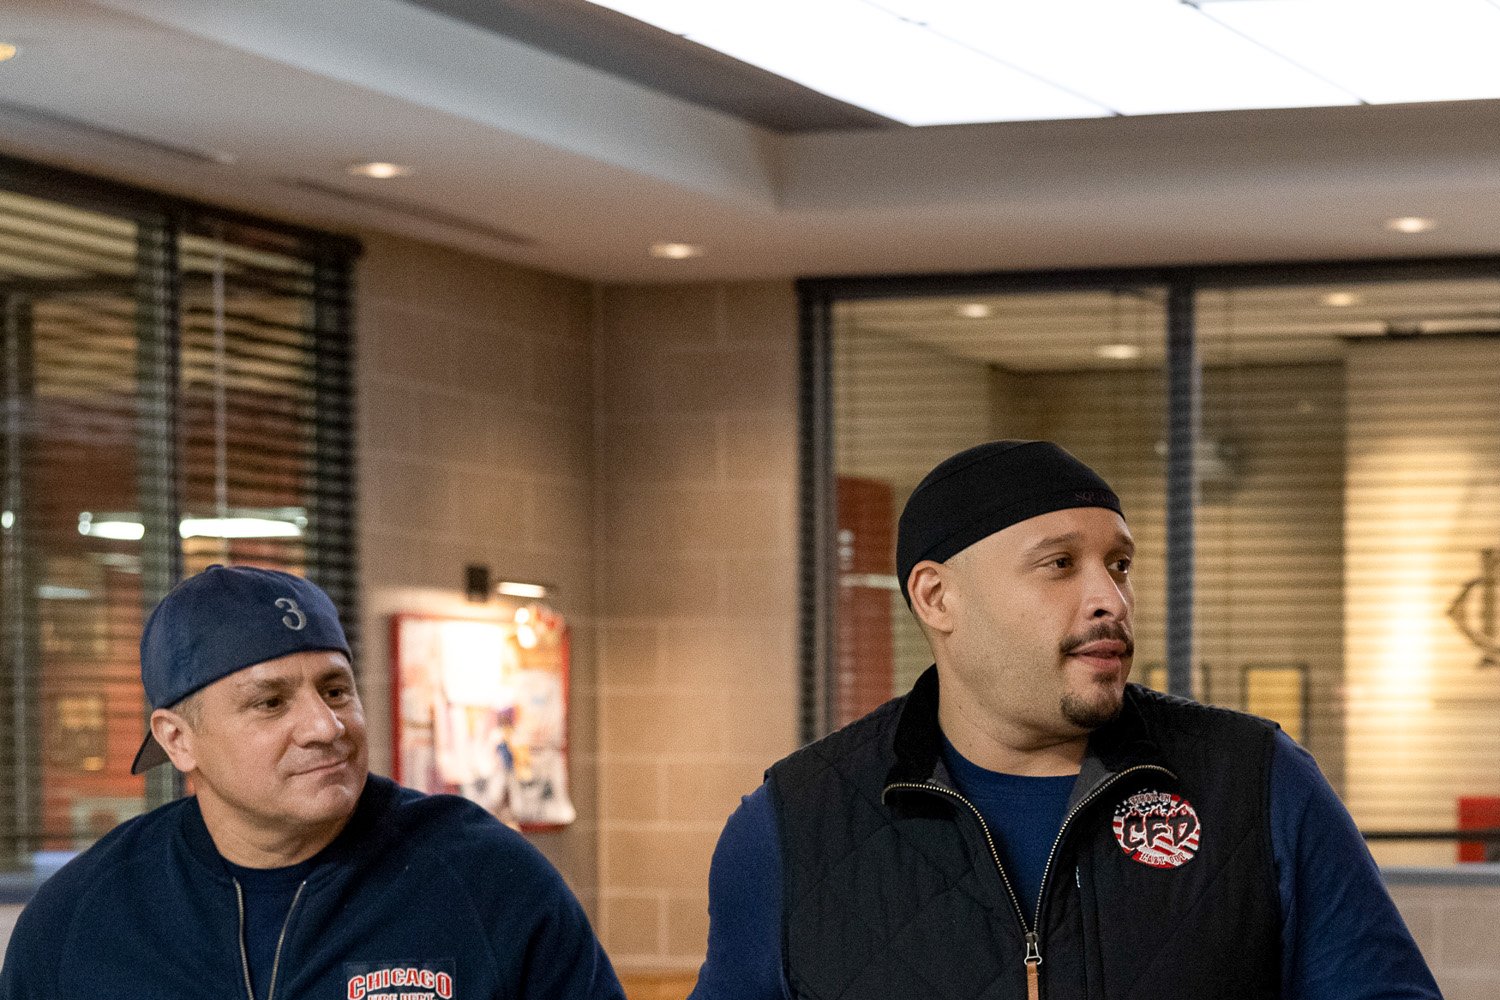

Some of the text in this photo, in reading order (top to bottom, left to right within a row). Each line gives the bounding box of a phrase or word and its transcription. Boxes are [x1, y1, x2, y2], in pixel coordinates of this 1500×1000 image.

[275, 598, 307, 630] 3
[1122, 804, 1198, 851] CFD
[348, 967, 452, 1000] CHICAGO
